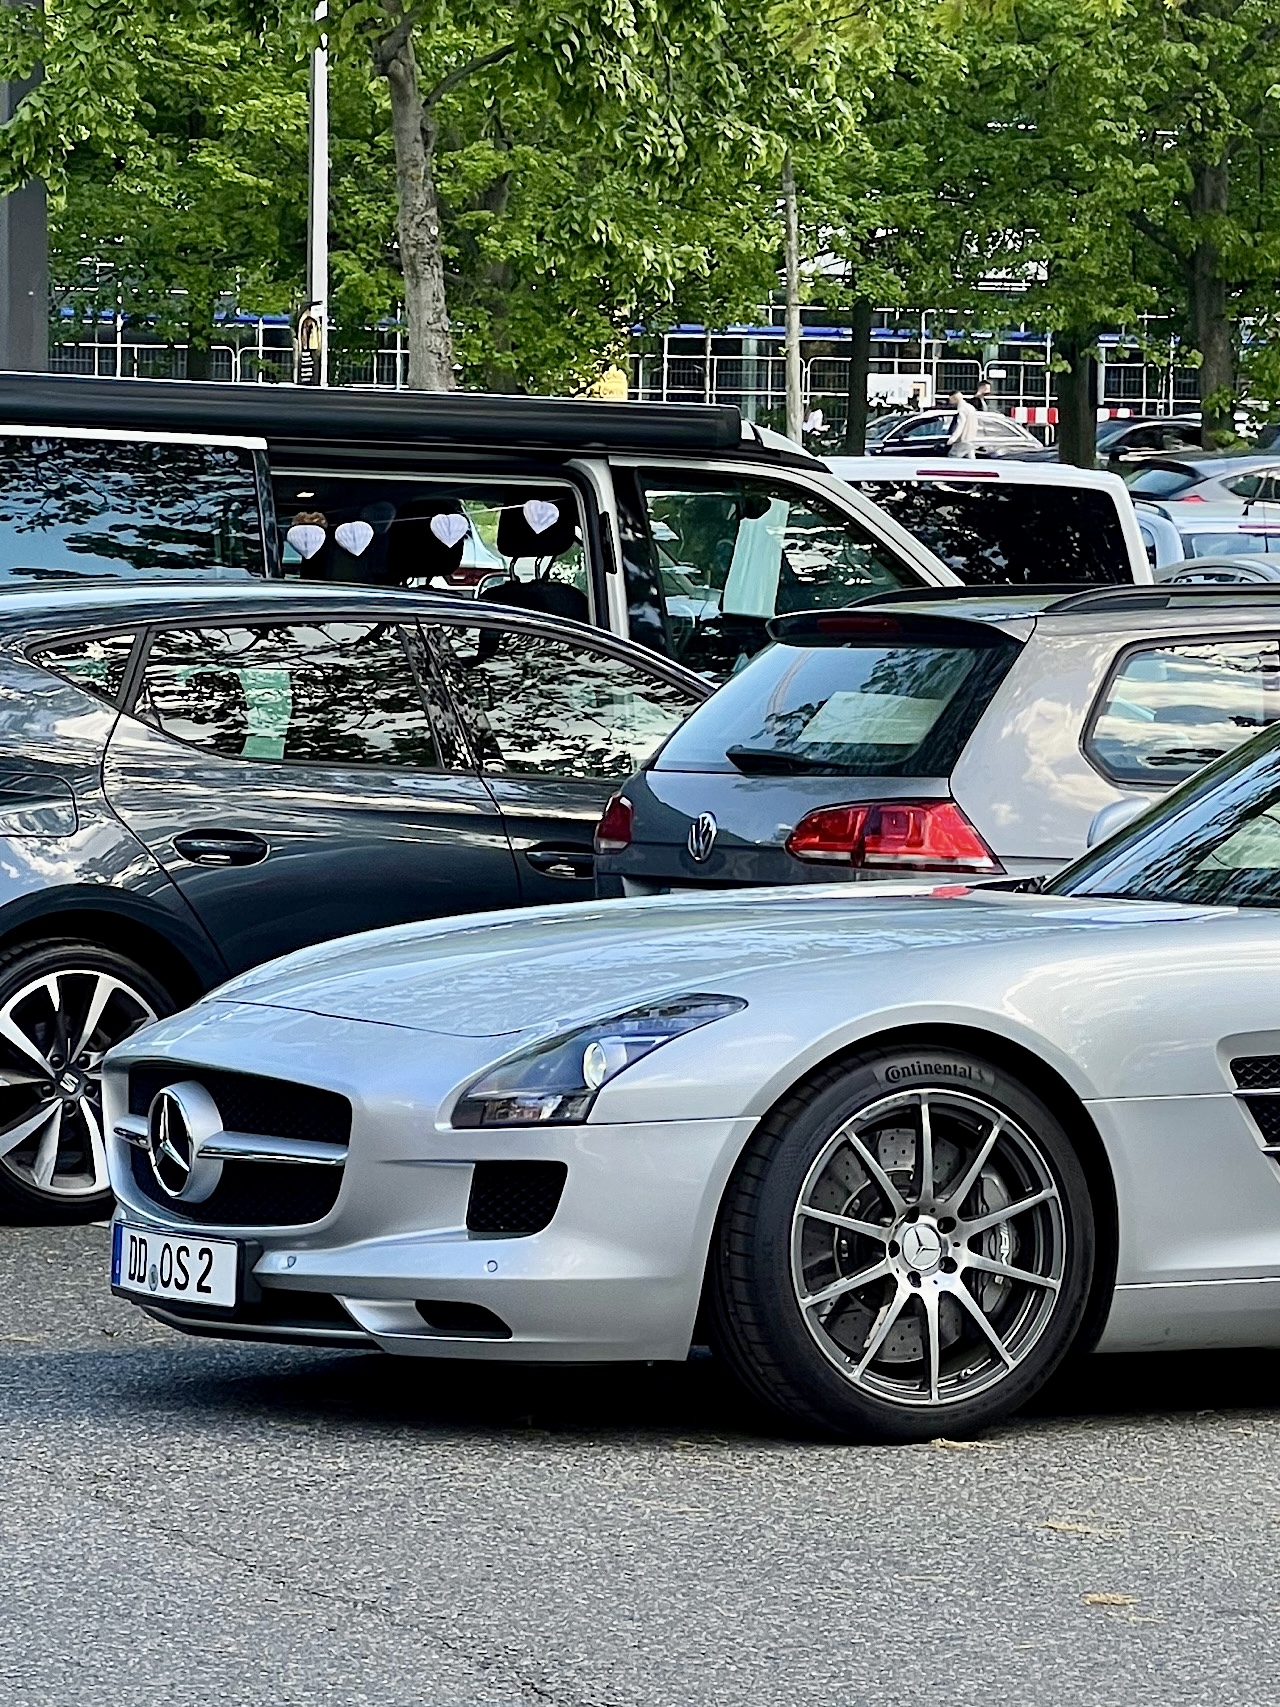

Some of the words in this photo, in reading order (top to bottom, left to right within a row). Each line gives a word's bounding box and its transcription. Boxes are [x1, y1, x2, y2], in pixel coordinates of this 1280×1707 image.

[884, 1060, 972, 1083] Continental
[128, 1234, 148, 1283] DD
[160, 1242, 190, 1291] OS
[196, 1247, 213, 1294] 2
